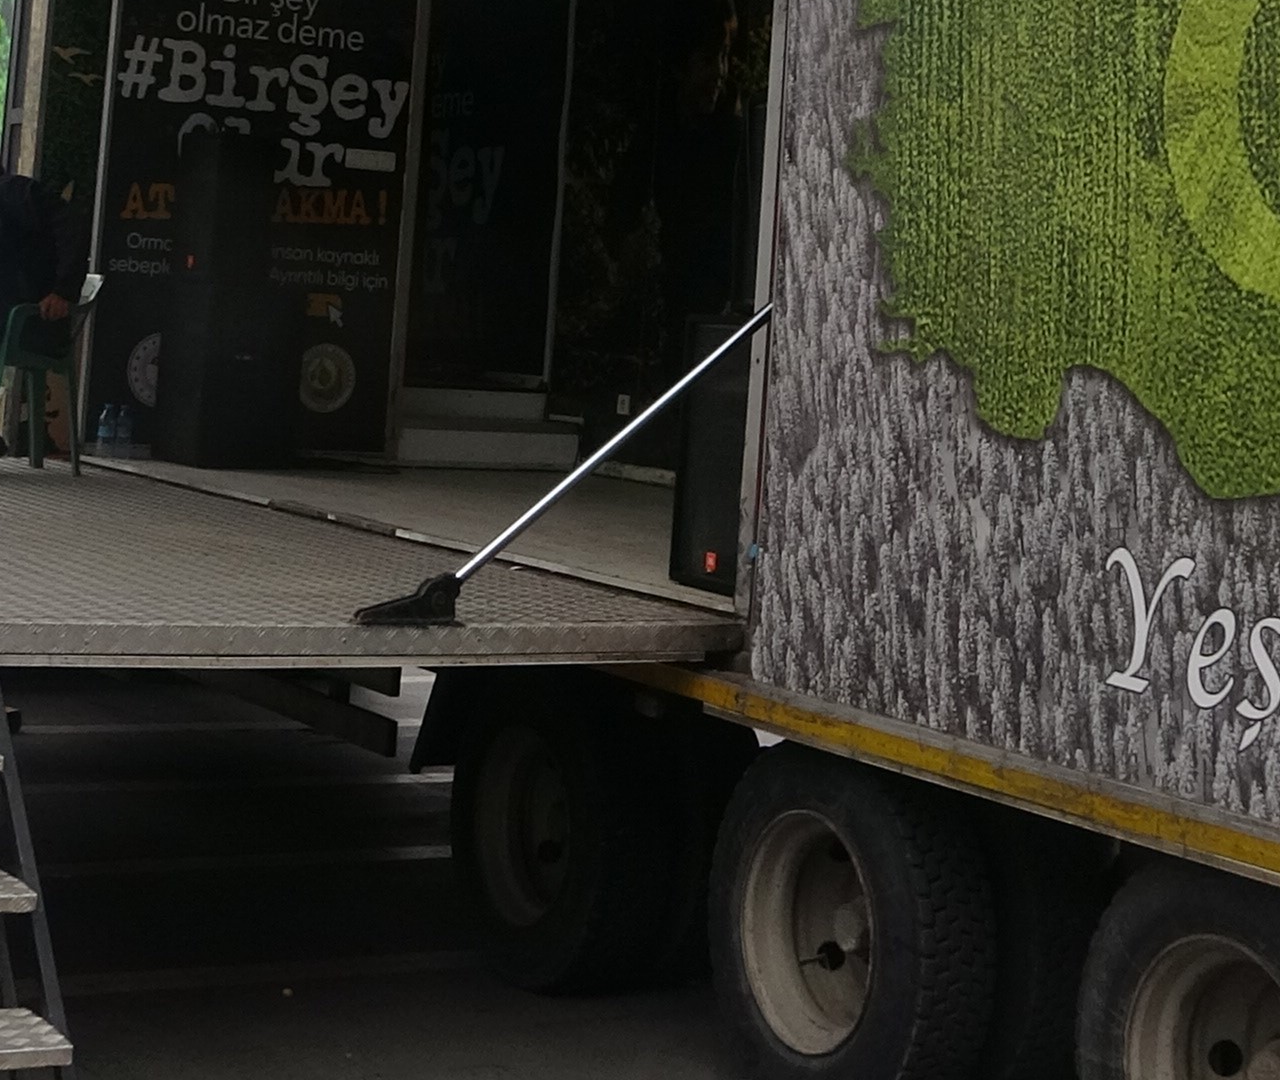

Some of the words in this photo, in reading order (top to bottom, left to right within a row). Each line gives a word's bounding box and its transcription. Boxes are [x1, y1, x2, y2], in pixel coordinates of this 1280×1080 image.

[176, 2, 270, 41] olmaz
[276, 14, 365, 52] deme
[116, 34, 410, 140] #BirŞey
[119, 181, 176, 221] AT
